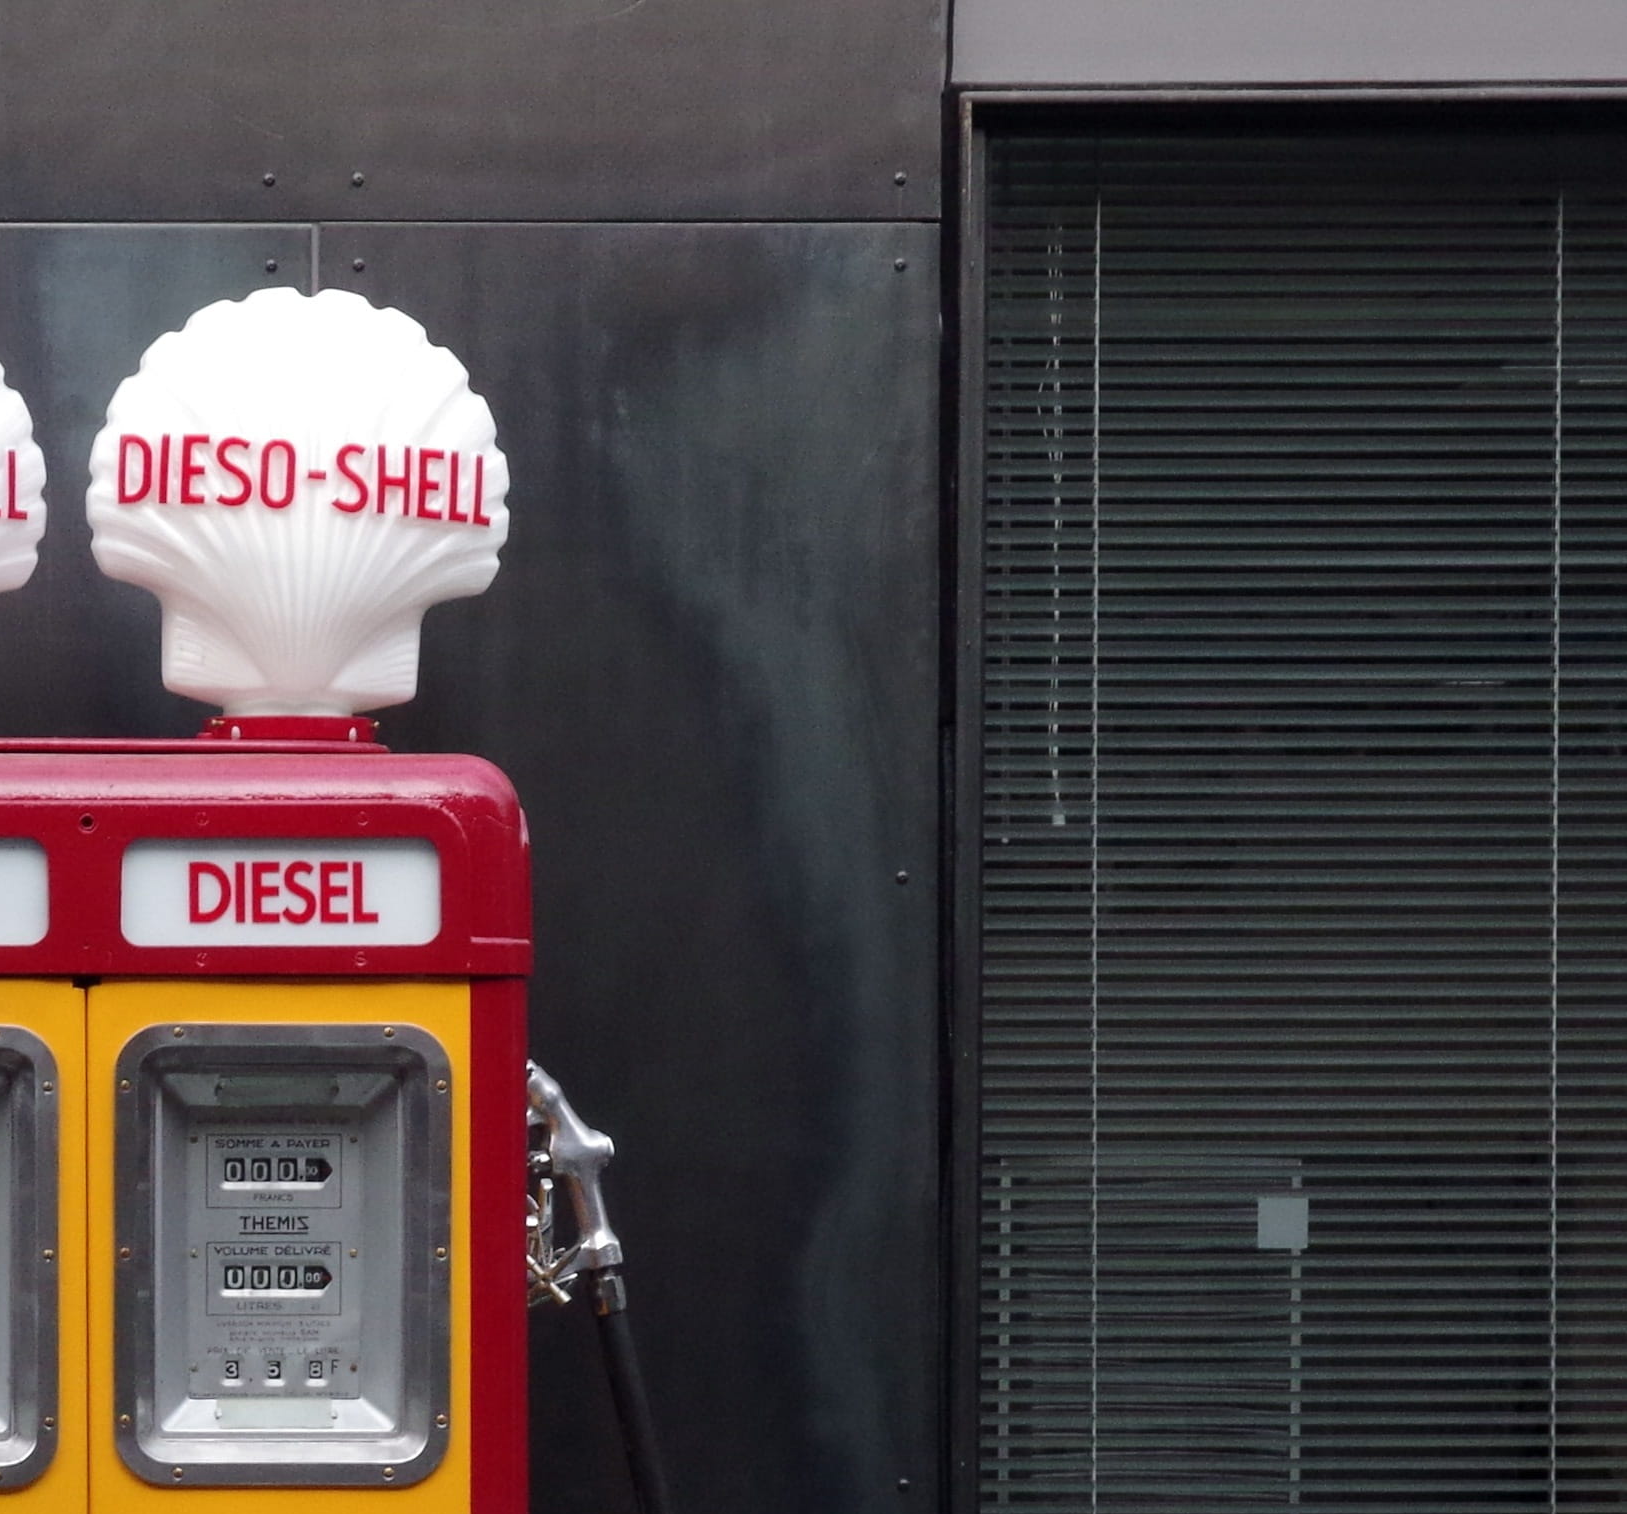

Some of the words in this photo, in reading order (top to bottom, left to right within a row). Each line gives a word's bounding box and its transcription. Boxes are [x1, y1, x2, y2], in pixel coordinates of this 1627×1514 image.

[117, 434, 491, 527] DIESO-SHELL
[188, 860, 379, 925] DIESEL
[215, 1138, 265, 1149] SOMME
[287, 1138, 331, 1148] PAYER
[239, 1215, 310, 1231] THEMIS
[213, 1246, 268, 1256] VOLUME
